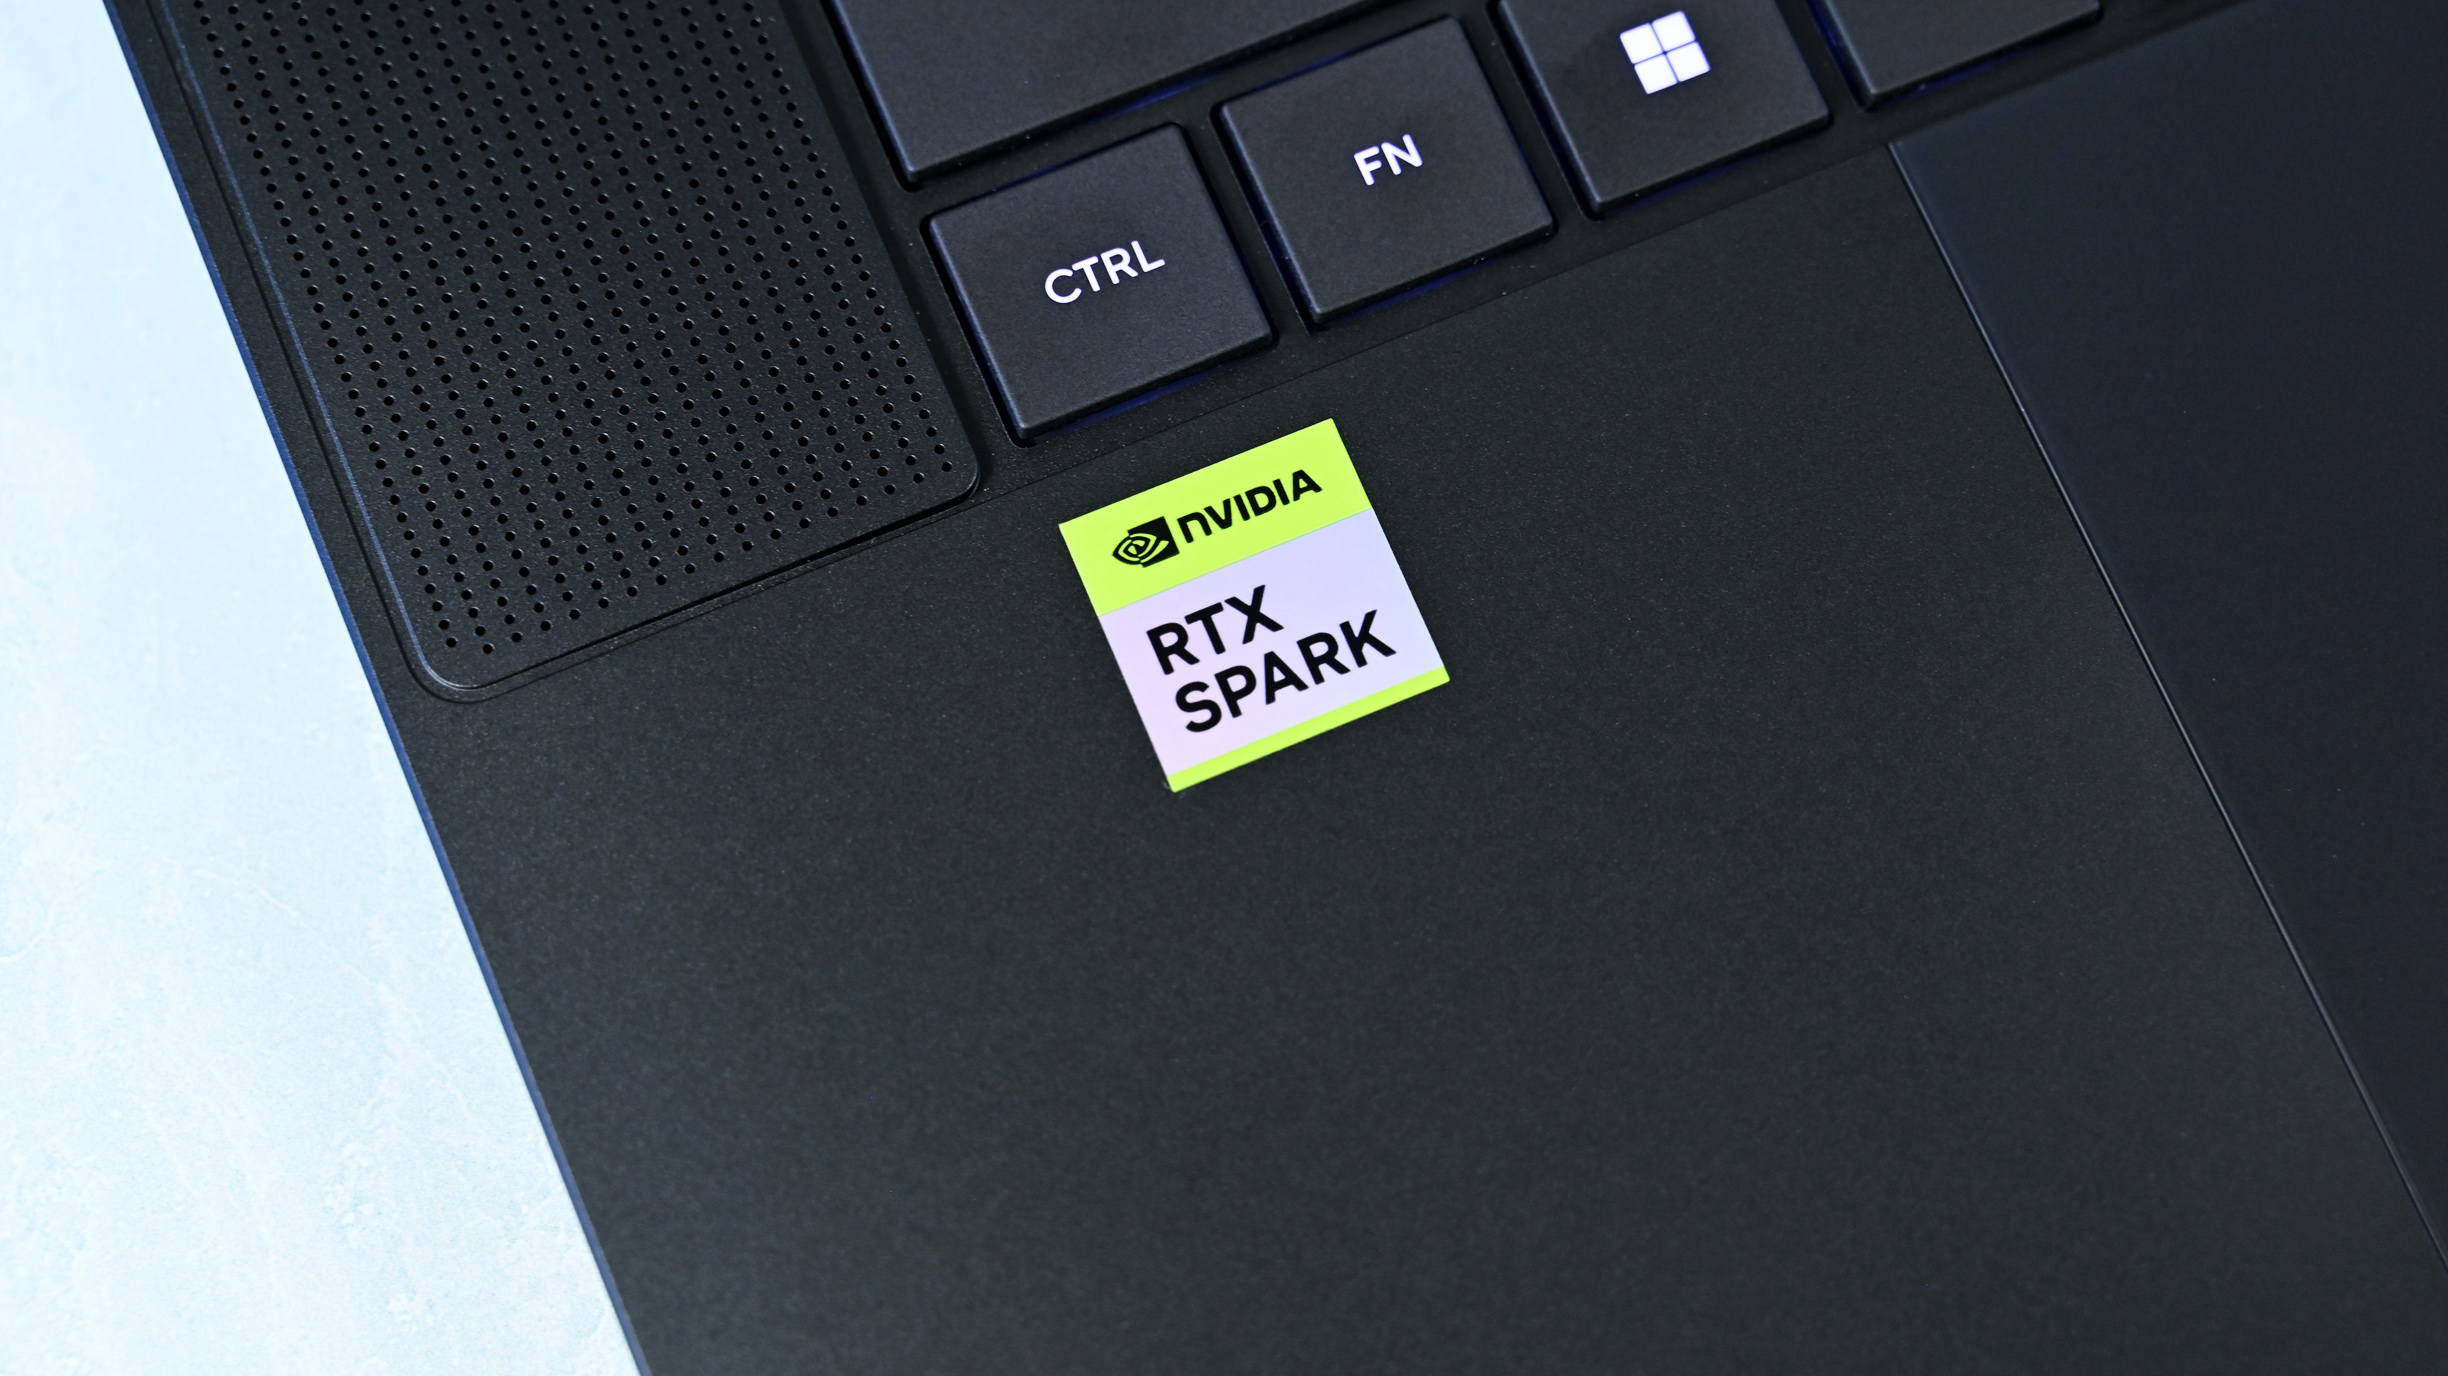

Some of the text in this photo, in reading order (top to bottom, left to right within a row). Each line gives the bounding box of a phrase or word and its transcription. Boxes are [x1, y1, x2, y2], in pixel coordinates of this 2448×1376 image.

[1353, 133, 1424, 187] FN
[1043, 239, 1167, 305] CTRL
[1146, 584, 1284, 676] RTX
[1175, 609, 1397, 733] SPARK
